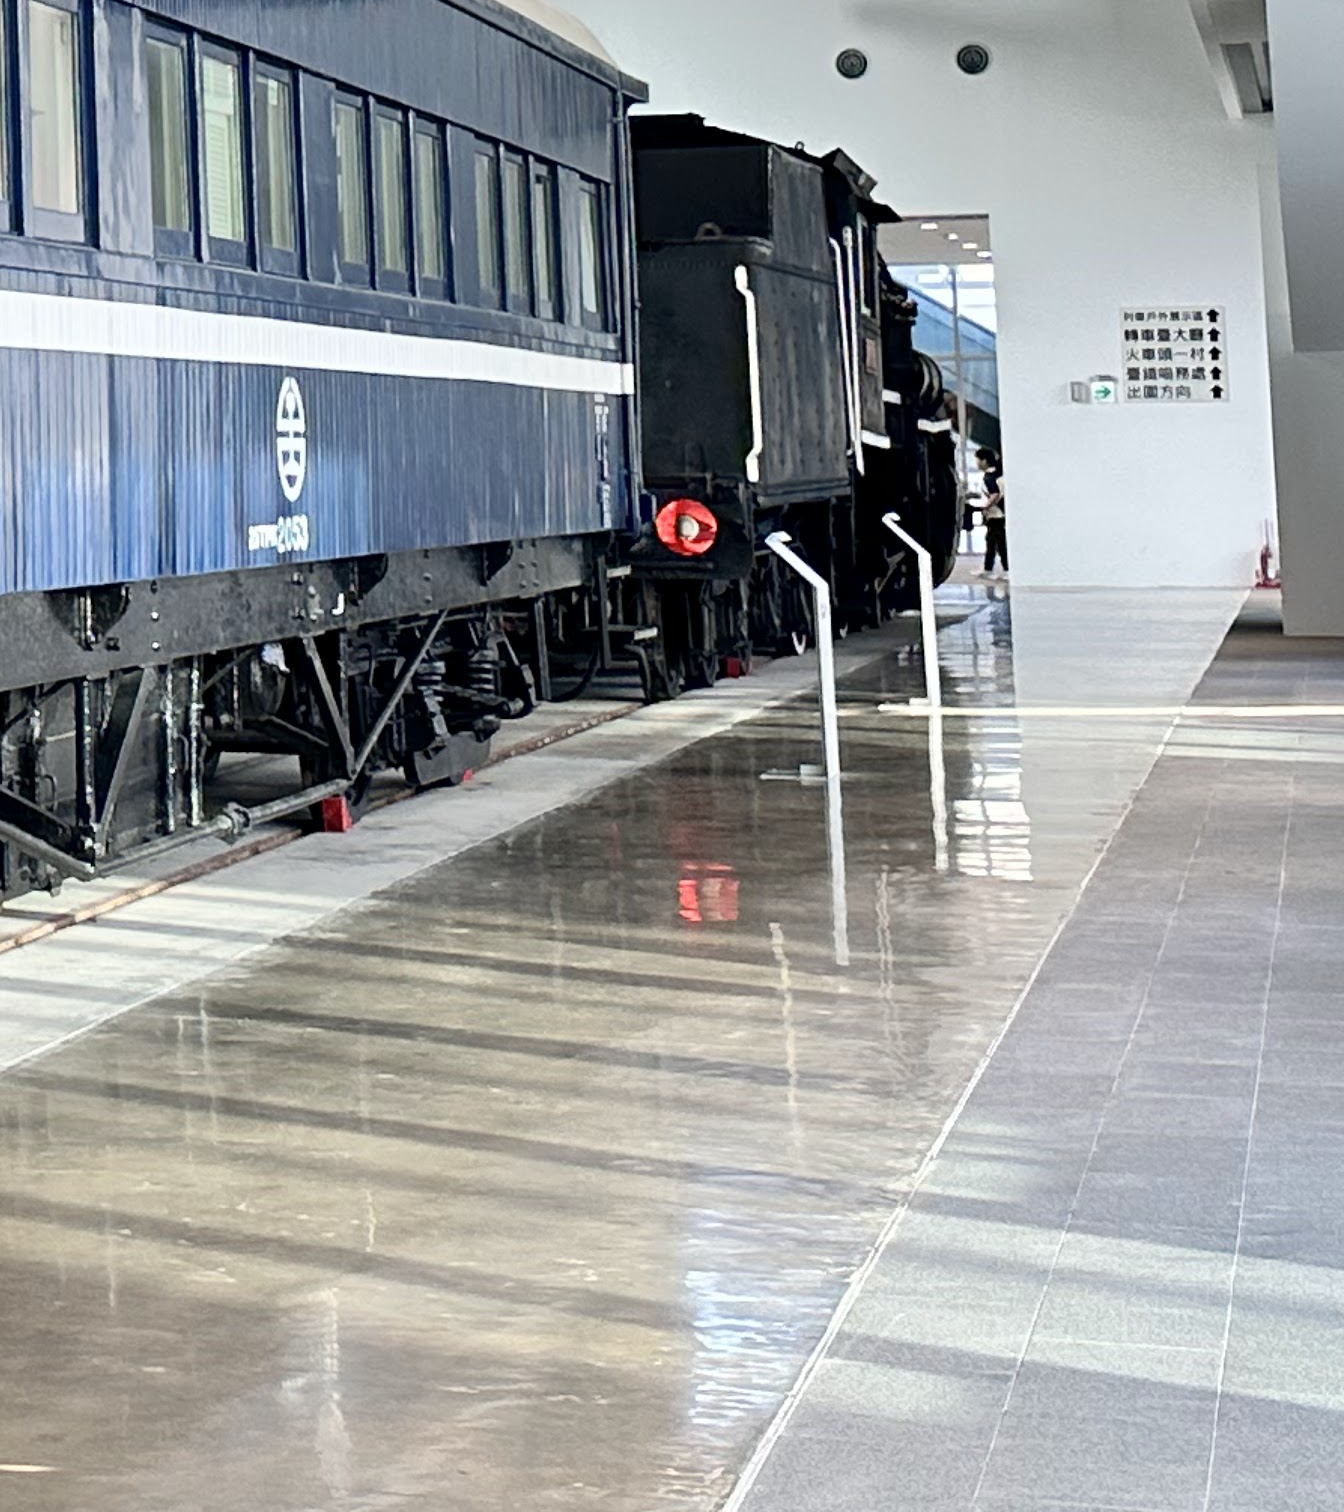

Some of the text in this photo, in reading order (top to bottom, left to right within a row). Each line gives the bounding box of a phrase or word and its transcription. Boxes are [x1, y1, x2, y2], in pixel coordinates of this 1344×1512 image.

[1125, 347, 1205, 361] 火車頭一村
